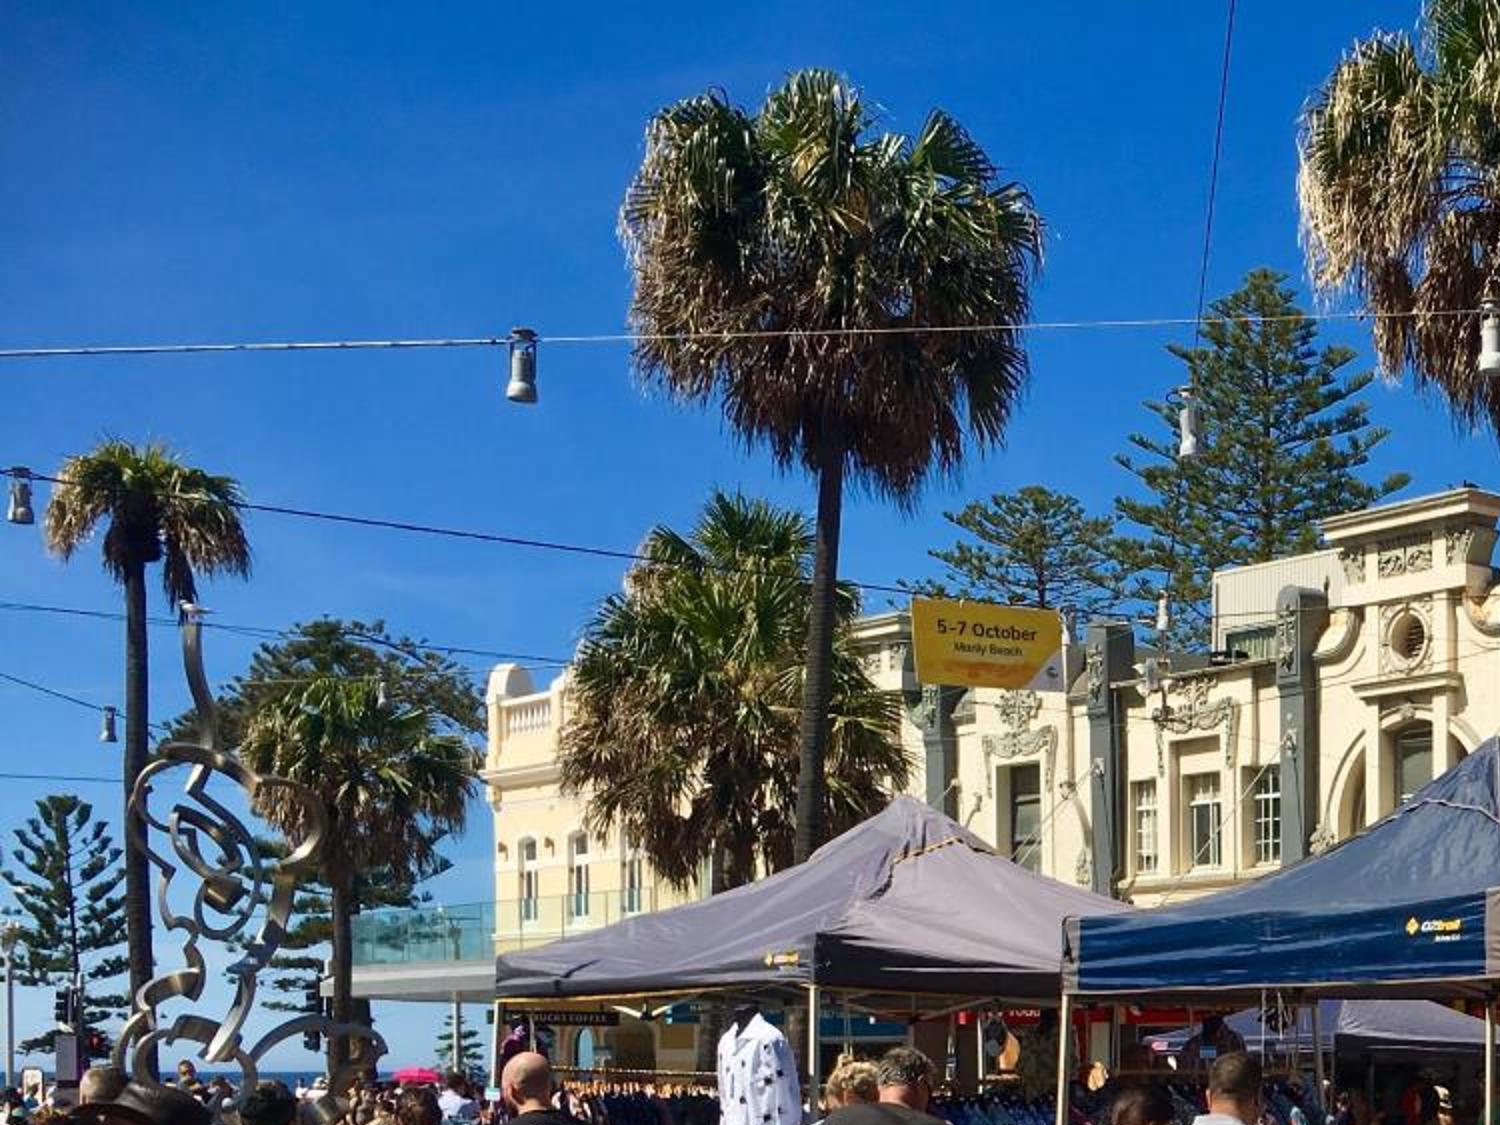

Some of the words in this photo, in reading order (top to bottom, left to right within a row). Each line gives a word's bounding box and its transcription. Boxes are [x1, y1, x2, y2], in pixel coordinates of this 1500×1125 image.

[971, 622, 1038, 641] October
[954, 640, 986, 657] Manly
[989, 642, 1024, 657] Beach
